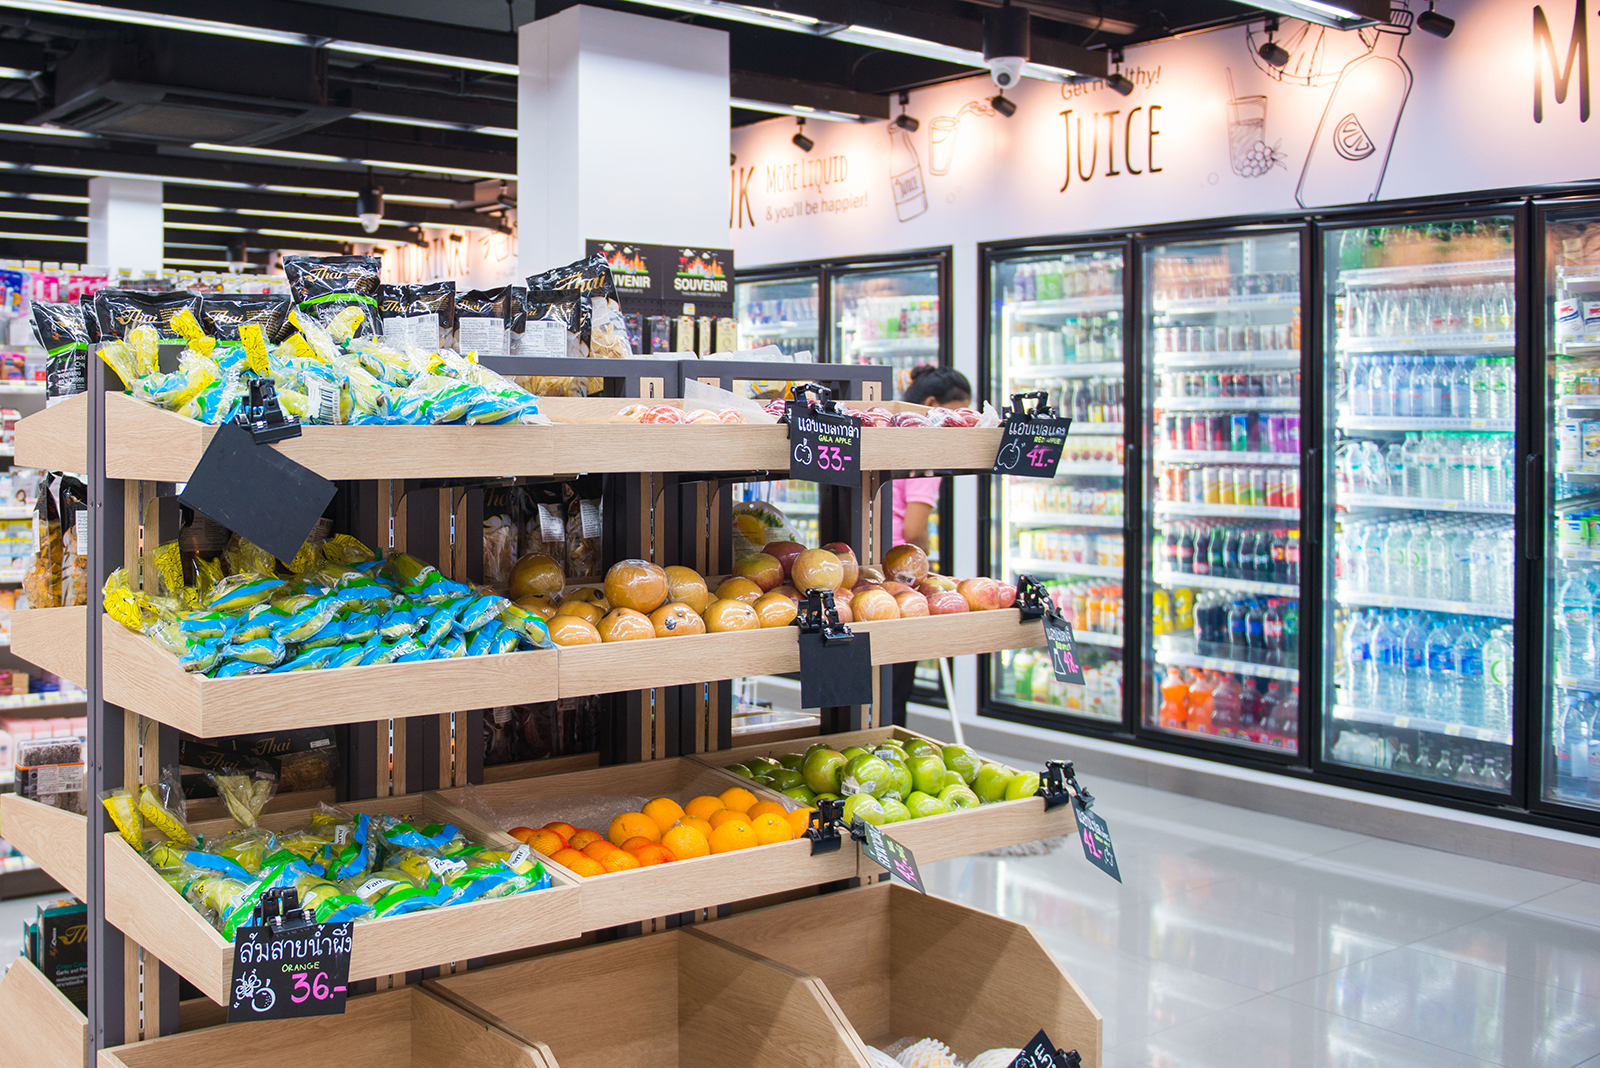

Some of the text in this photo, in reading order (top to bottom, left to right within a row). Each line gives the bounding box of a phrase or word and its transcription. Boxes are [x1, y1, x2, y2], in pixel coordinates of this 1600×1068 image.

[1532, 0, 1600, 124] M
[1060, 105, 1163, 193] JUICE
[766, 155, 848, 194] MORE LIQUID
[766, 206, 773, 221] &
[805, 200, 819, 215] be
[821, 191, 868, 214] happier!
[304, 267, 344, 282] Thai
[614, 274, 651, 288] UVENIR
[674, 277, 728, 292] SOUVENIR
[379, 299, 411, 313] Thai
[115, 309, 158, 325] Thai
[818, 434, 853, 446] GALA APPLE
[817, 445, 853, 471] 33.-
[250, 737, 292, 757] Thai
[198, 751, 241, 770] Thai
[239, 922, 353, 964] ส้มสายน้ำผึ้ง
[281, 961, 321, 974] ORANGE
[290, 971, 347, 1004] 36.-
